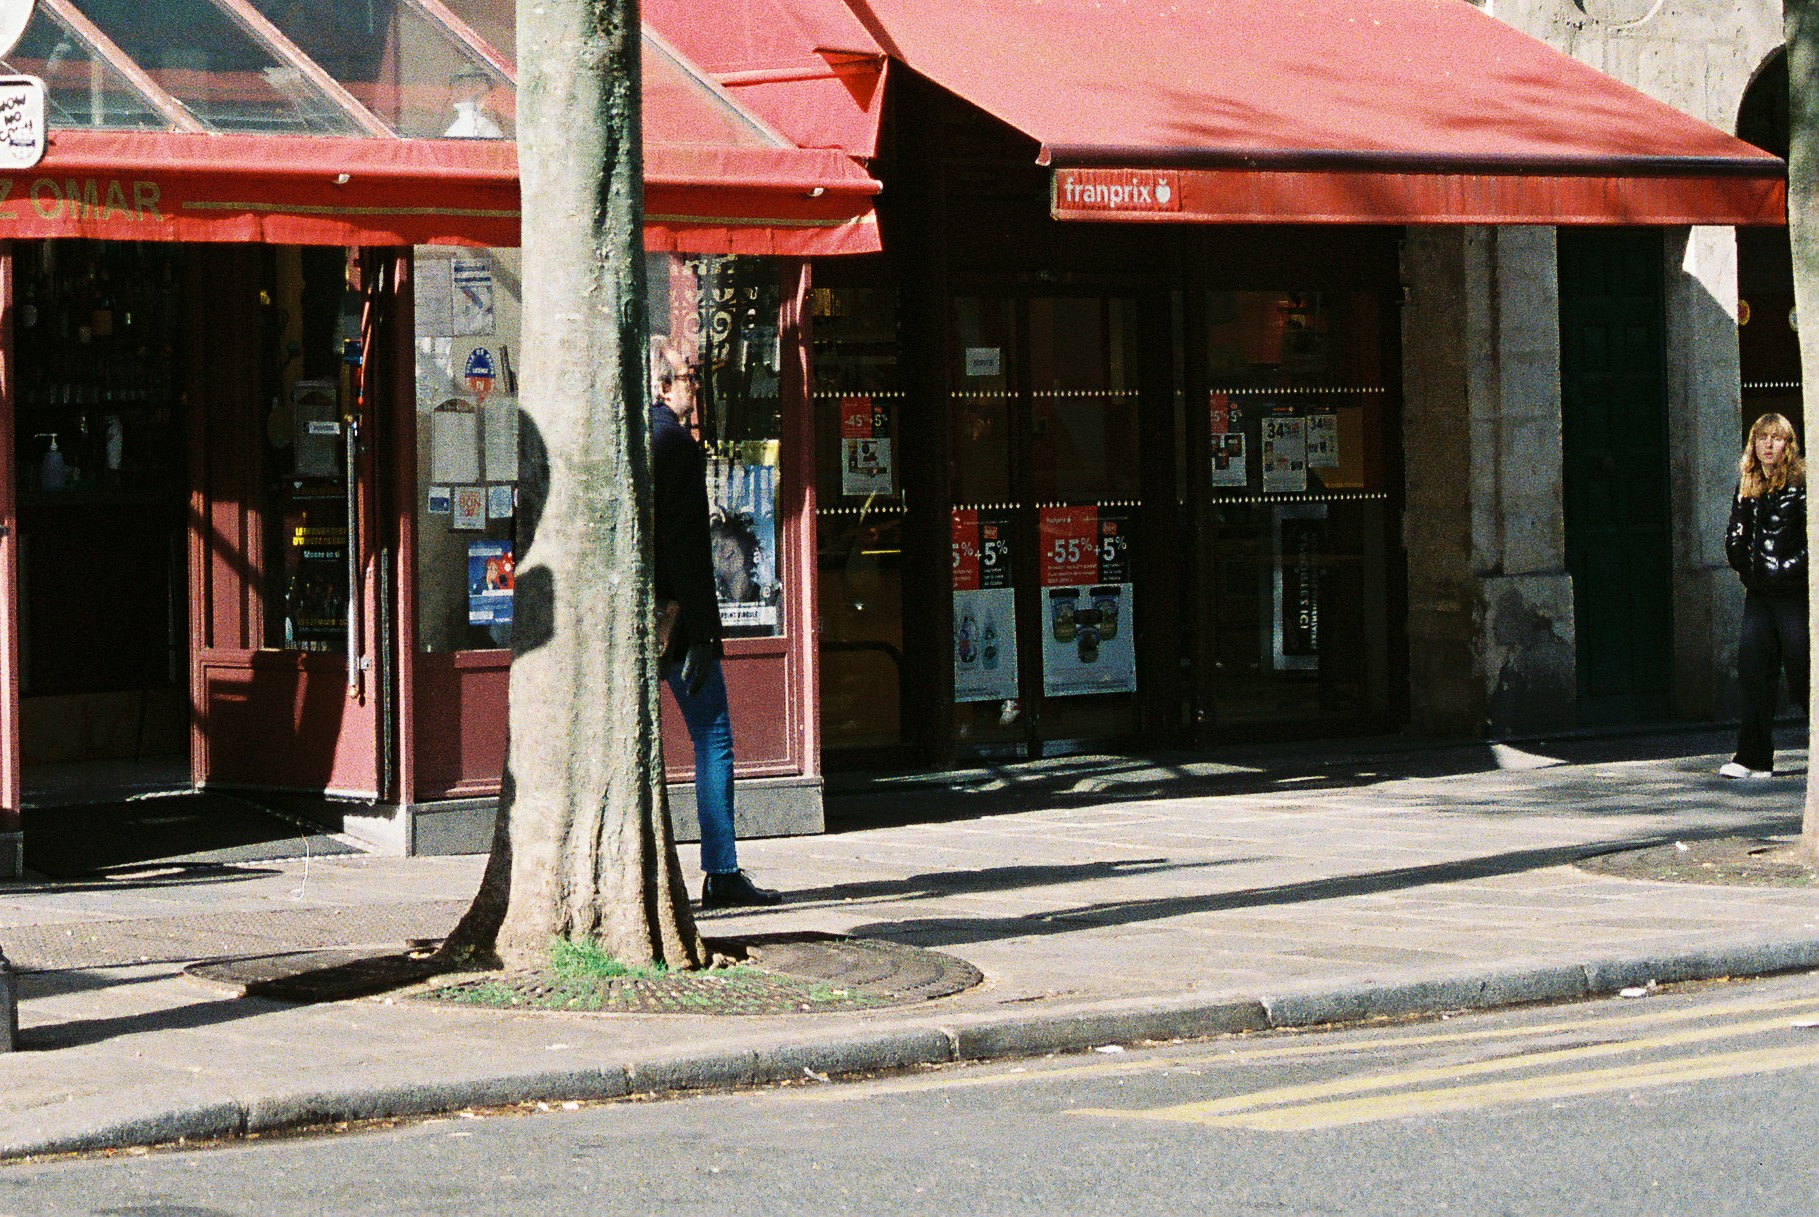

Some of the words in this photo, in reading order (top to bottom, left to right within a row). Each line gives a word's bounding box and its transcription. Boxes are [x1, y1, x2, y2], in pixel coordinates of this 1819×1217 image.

[30, 177, 164, 222] OMAR
[1064, 176, 1152, 208] franprix
[1046, 536, 1092, 563] -55%
